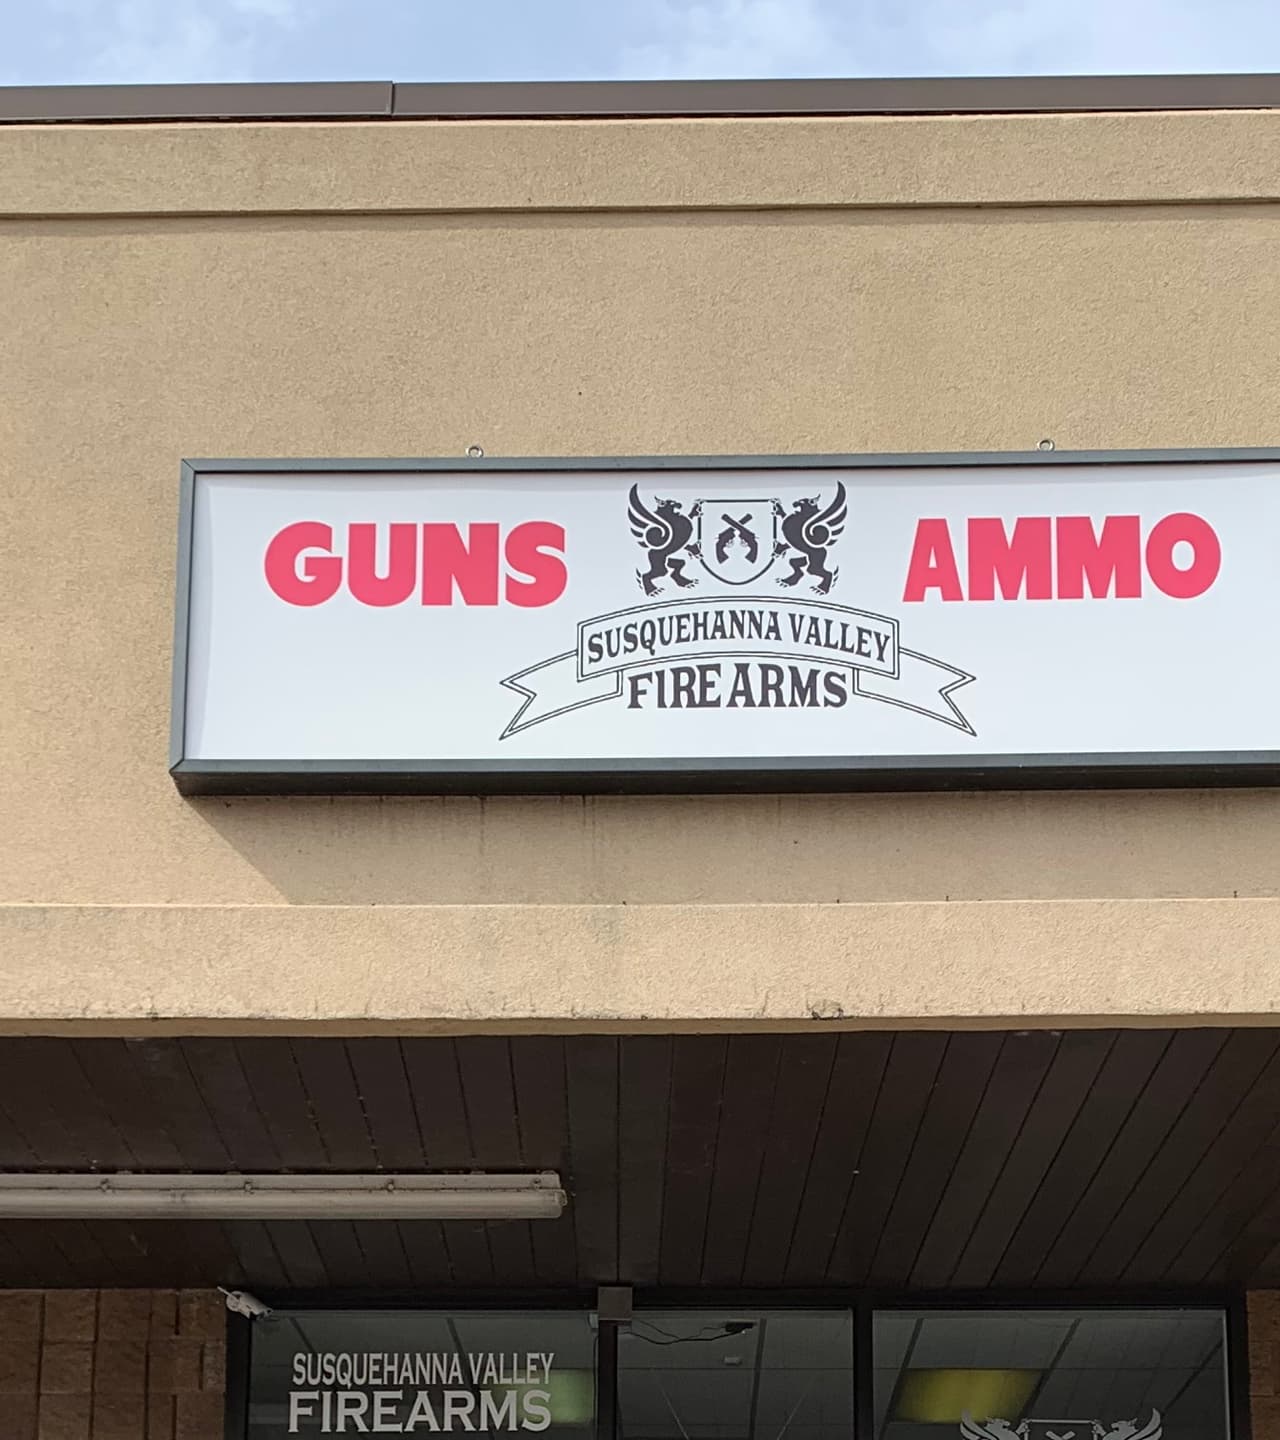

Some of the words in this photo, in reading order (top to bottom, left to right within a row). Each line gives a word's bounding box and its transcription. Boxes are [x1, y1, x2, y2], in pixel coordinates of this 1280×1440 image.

[264, 520, 569, 607] GUNS
[903, 513, 1222, 603] AMMO
[587, 609, 783, 665] SUSQUEHANNA
[788, 613, 891, 662] VALLEY
[293, 1352, 464, 1388] SUSQUEHANNA
[469, 1352, 554, 1385] VALLEY
[288, 1390, 552, 1433] FIREARMS
